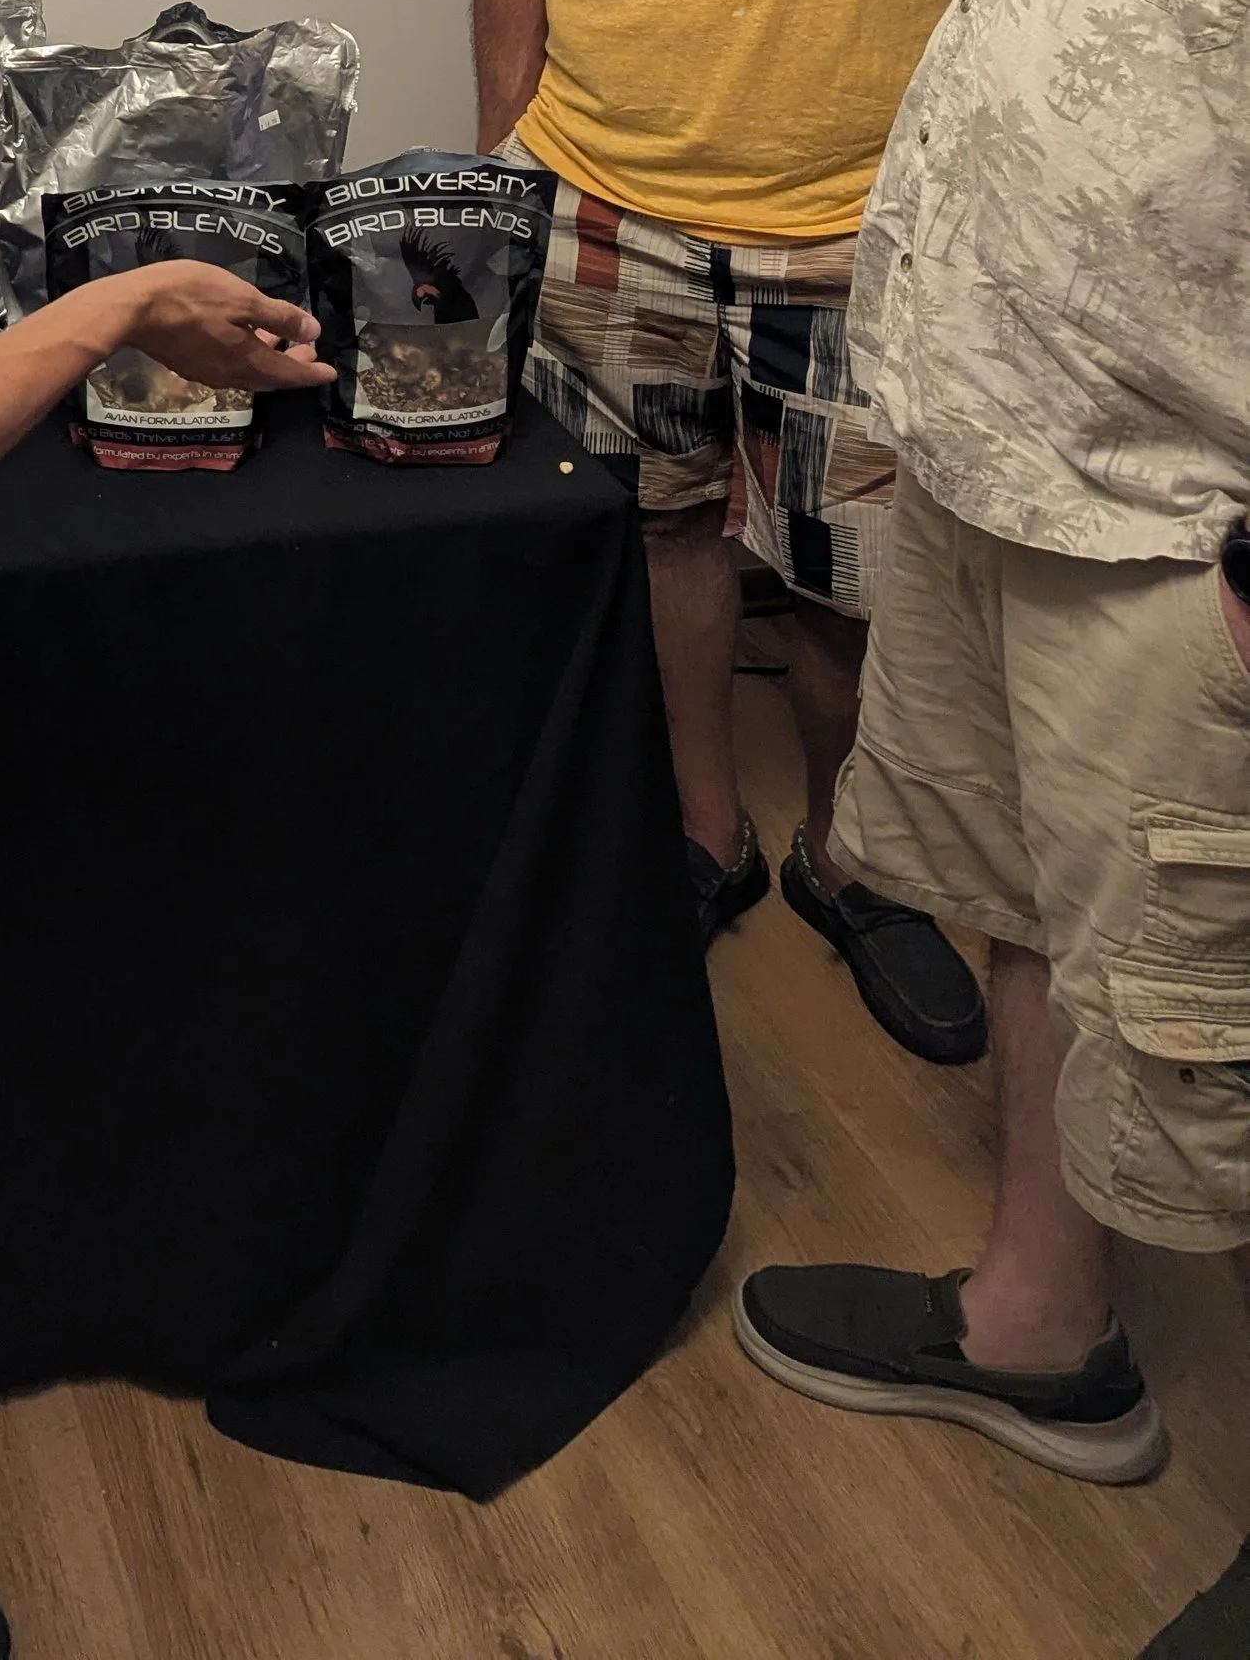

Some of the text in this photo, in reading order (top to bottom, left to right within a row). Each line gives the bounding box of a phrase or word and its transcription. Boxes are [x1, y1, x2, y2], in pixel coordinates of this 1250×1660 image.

[325, 171, 537, 207] BIODIVERSITY
[62, 210, 284, 256] BIRD BLENDS
[324, 207, 533, 249] BIRD BLENDS
[104, 412, 231, 426] AVIAN FORMULATIONS
[371, 412, 406, 425] AVIAN
[407, 408, 492, 425] FORMULATIONS
[100, 428, 132, 441] Birds
[146, 451, 161, 462] by
[202, 450, 213, 459] in
